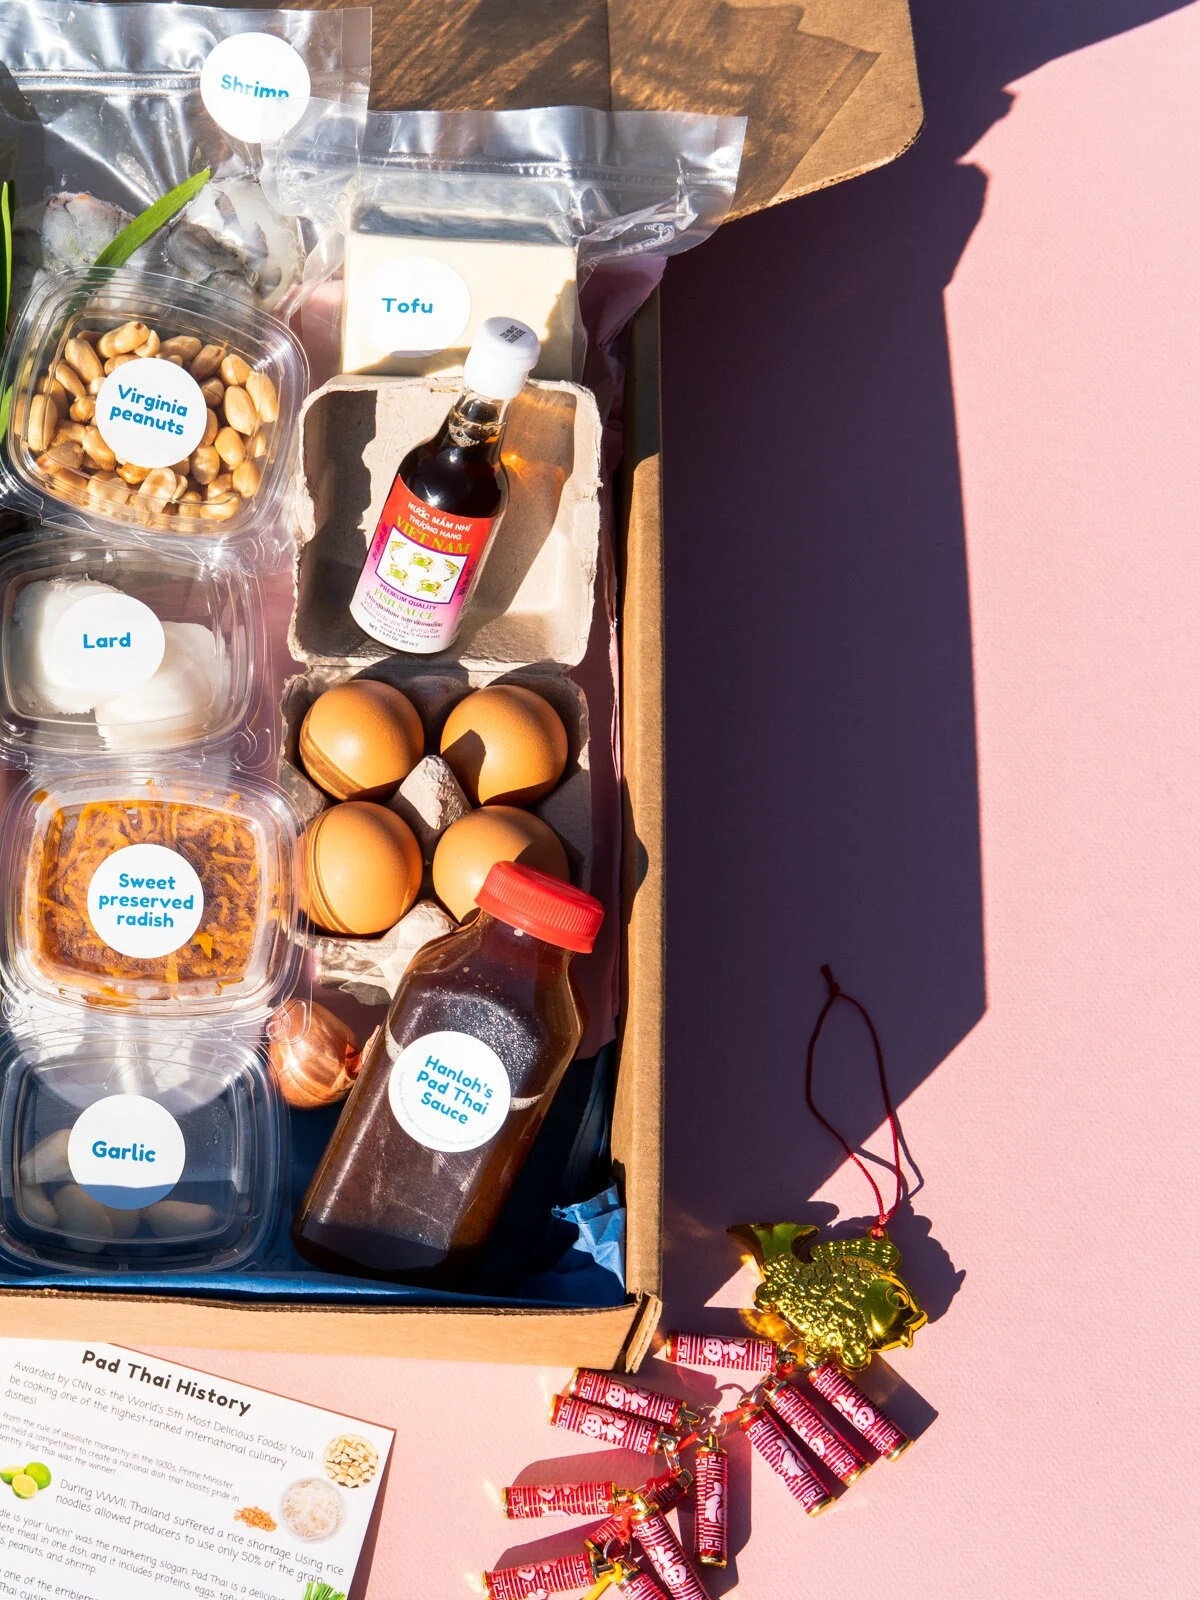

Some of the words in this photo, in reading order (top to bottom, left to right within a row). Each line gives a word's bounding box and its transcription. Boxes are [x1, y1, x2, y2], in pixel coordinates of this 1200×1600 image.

[382, 297, 433, 314] Tofu
[117, 384, 188, 417] Virginia
[109, 405, 185, 436] peanuts
[432, 537, 472, 554] NAM
[380, 583, 407, 602] PREMIUM
[408, 600, 438, 611] QUALITY
[83, 631, 131, 649] Lard
[118, 873, 176, 891] Sweet
[98, 893, 194, 911] preserved
[116, 911, 174, 928] radish
[424, 1055, 494, 1099] Hanloh's
[416, 1070, 450, 1095] Pad
[454, 1086, 489, 1115] Thai
[420, 1092, 469, 1125] Sauce
[92, 1140, 156, 1163] Garlic
[4, 1387, 37, 1404] dishes!
[81, 1349, 120, 1373] Pad
[127, 1363, 171, 1389] Thai
[175, 1378, 251, 1416] History
[9, 1374, 20, 1385] be
[23, 1379, 58, 1400] cooking
[59, 1391, 77, 1402] one
[79, 1397, 92, 1406] of
[93, 1399, 108, 1412] the
[110, 1404, 182, 1434] highest-ranked
[184, 1429, 246, 1454] international
[248, 1449, 287, 1469] culinary
[13, 1361, 55, 1380] Awarded
[57, 1373, 69, 1388] by
[71, 1378, 92, 1391] CNN
[94, 1385, 105, 1396] as
[109, 1389, 124, 1401] the
[127, 1393, 164, 1414] World's
[166, 1406, 183, 1420] 5th
[186, 1412, 211, 1428] Most
[213, 1420, 254, 1442] Delicious
[256, 1434, 287, 1452] Foods!
[290, 1443, 316, 1461] You'll
